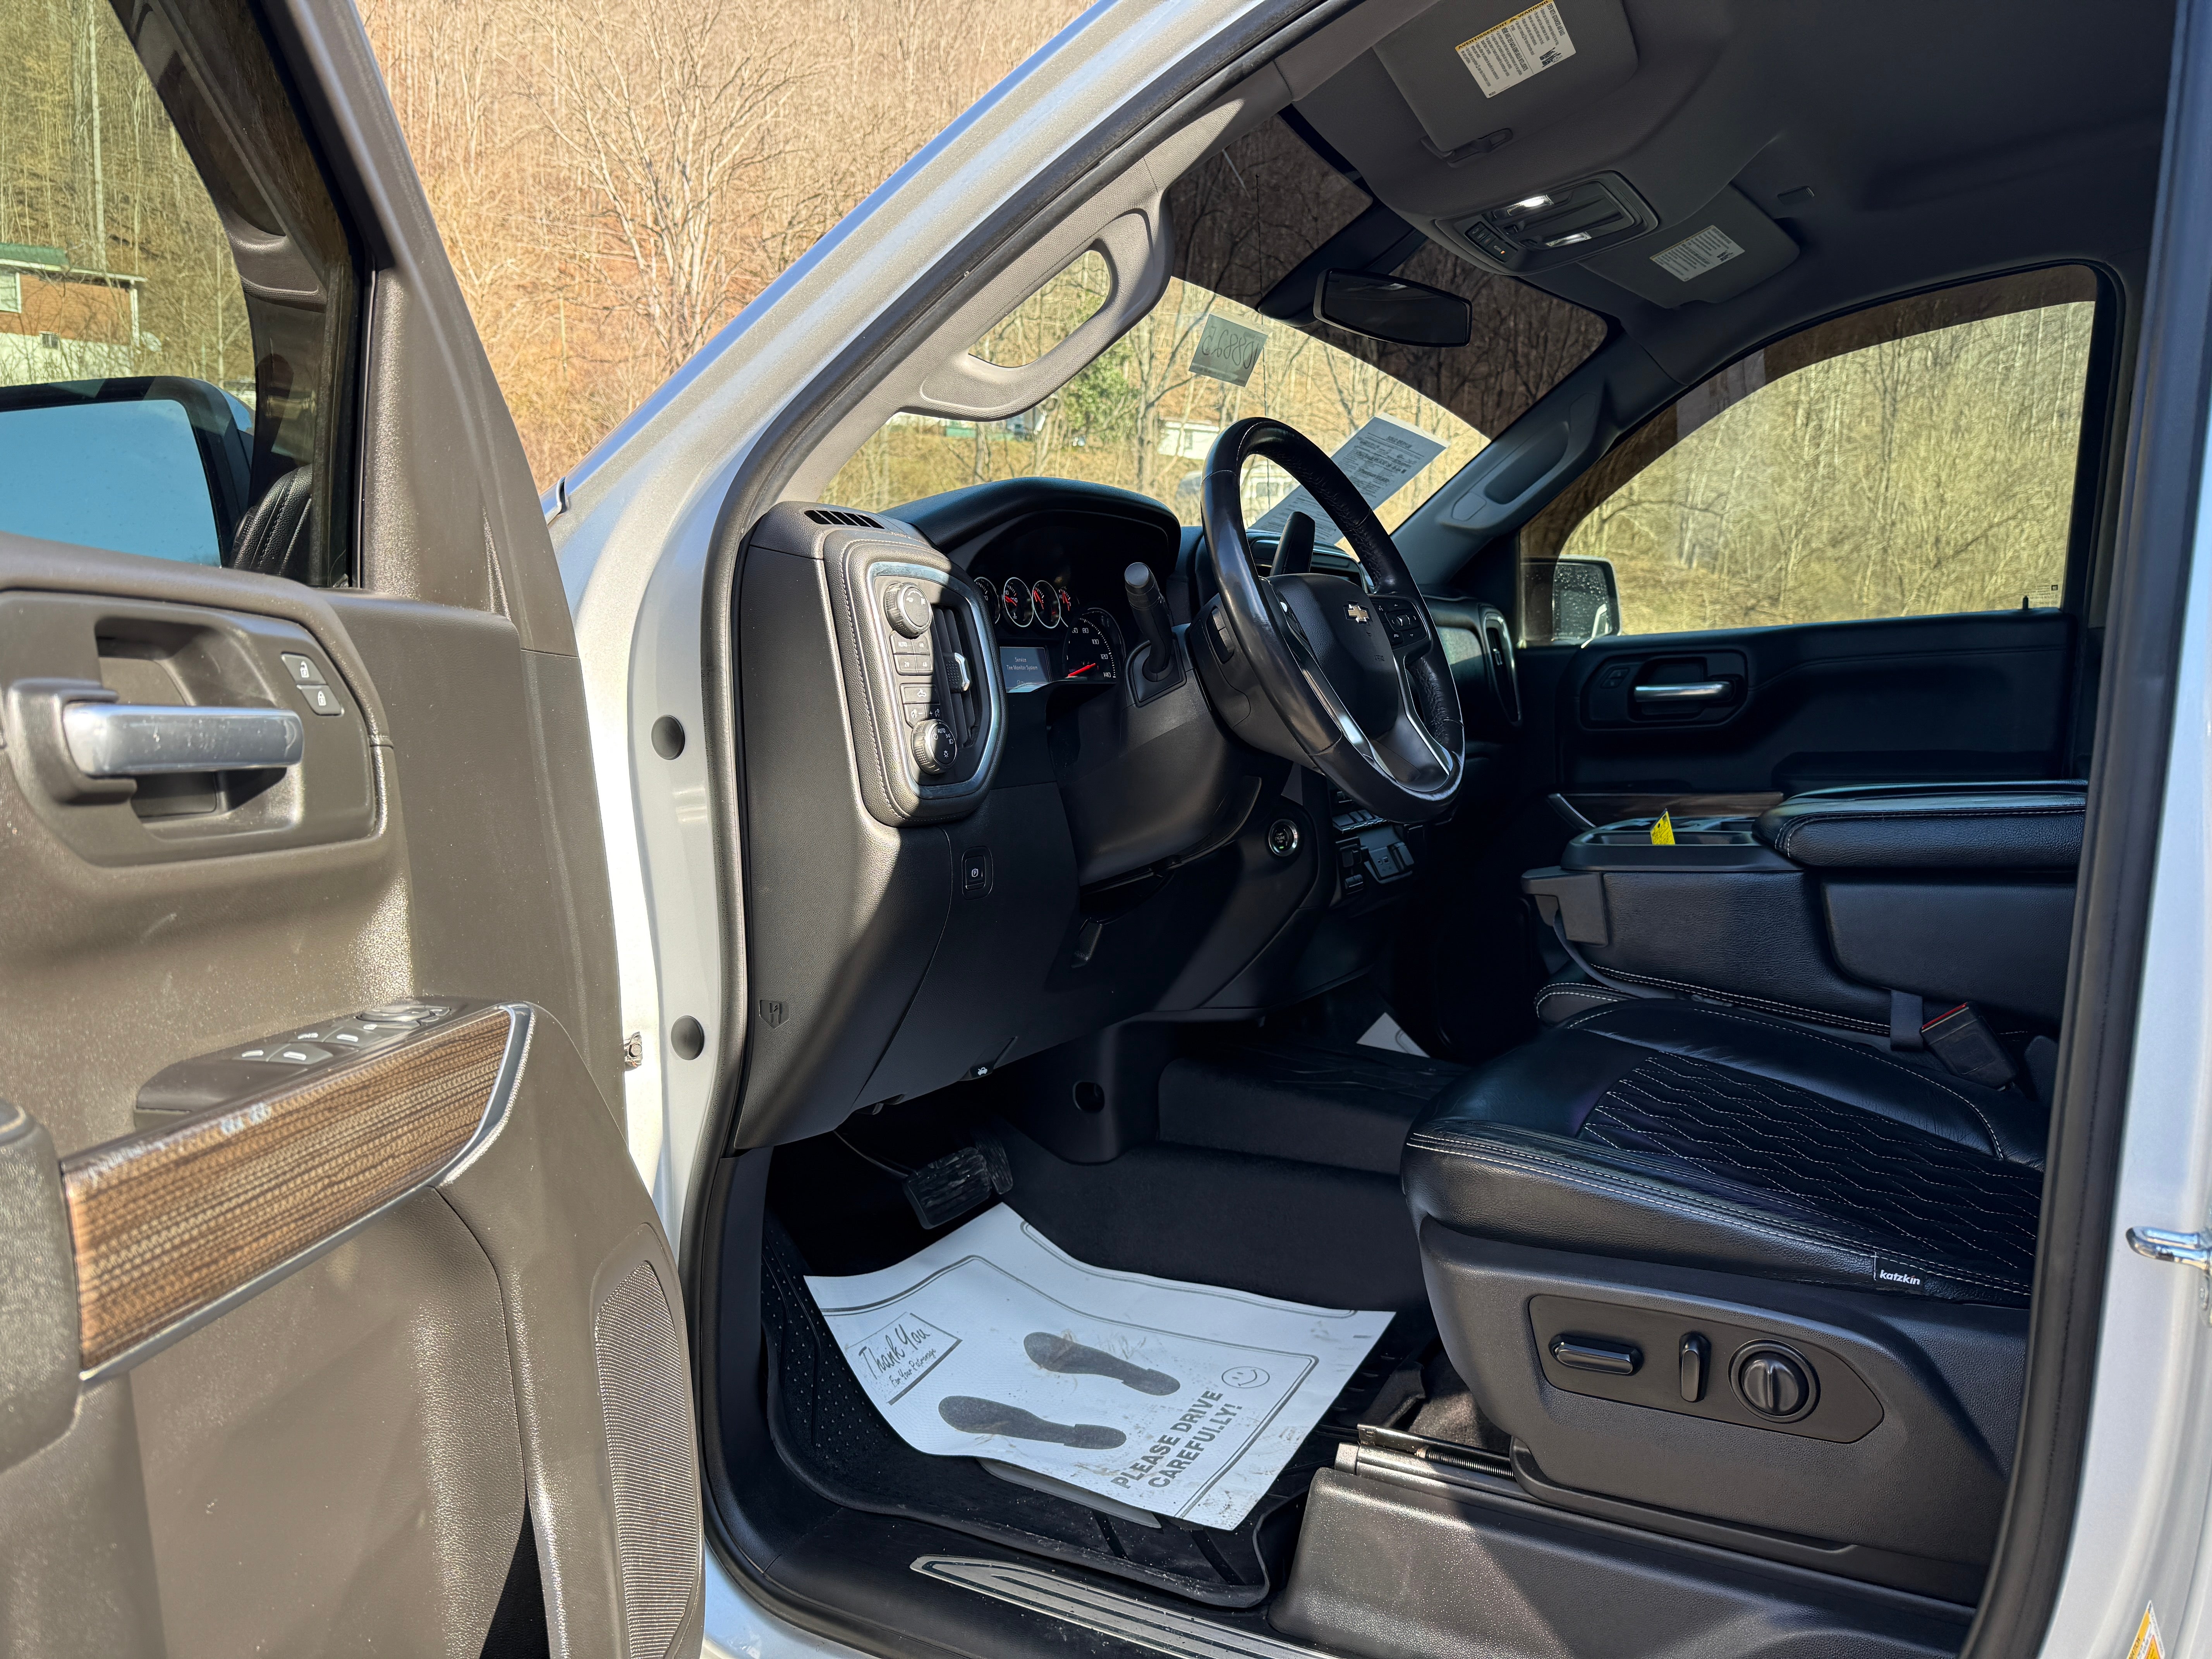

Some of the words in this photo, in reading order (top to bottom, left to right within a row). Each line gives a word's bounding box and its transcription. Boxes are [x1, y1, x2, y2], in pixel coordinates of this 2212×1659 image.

[1517, 0, 1549, 17] WARNING
[1879, 1269, 1920, 1285] katzkin
[859, 1334, 905, 1380] Thank
[895, 1324, 931, 1350] You
[889, 1375, 901, 1387] For
[1111, 1434, 1181, 1489] PLEASE
[1170, 1390, 1223, 1432] DRIVE
[1148, 1403, 1243, 1487] CAREFULLY!
